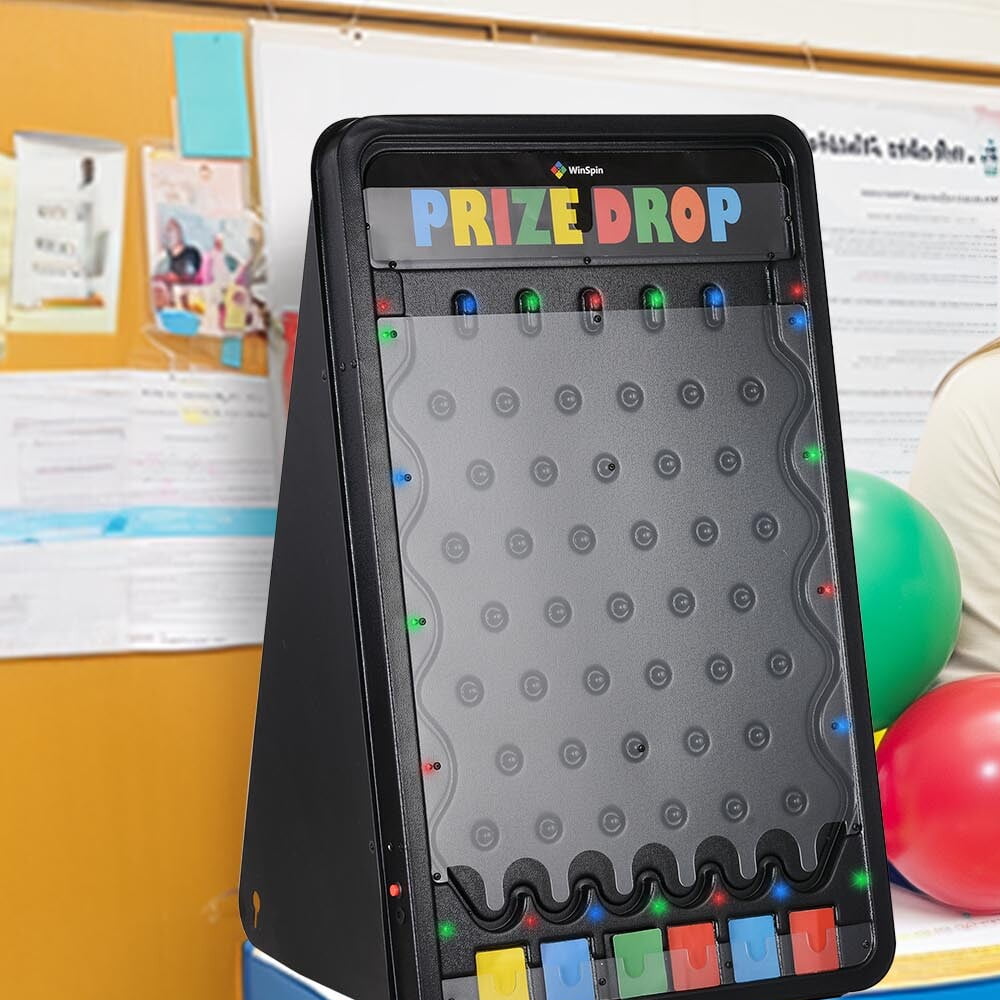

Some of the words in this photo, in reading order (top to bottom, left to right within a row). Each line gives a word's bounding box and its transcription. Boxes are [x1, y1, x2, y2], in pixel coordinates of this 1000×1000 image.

[568, 165, 604, 177] WinSpin
[410, 187, 584, 247] PRIZE
[593, 186, 742, 245] DROP
